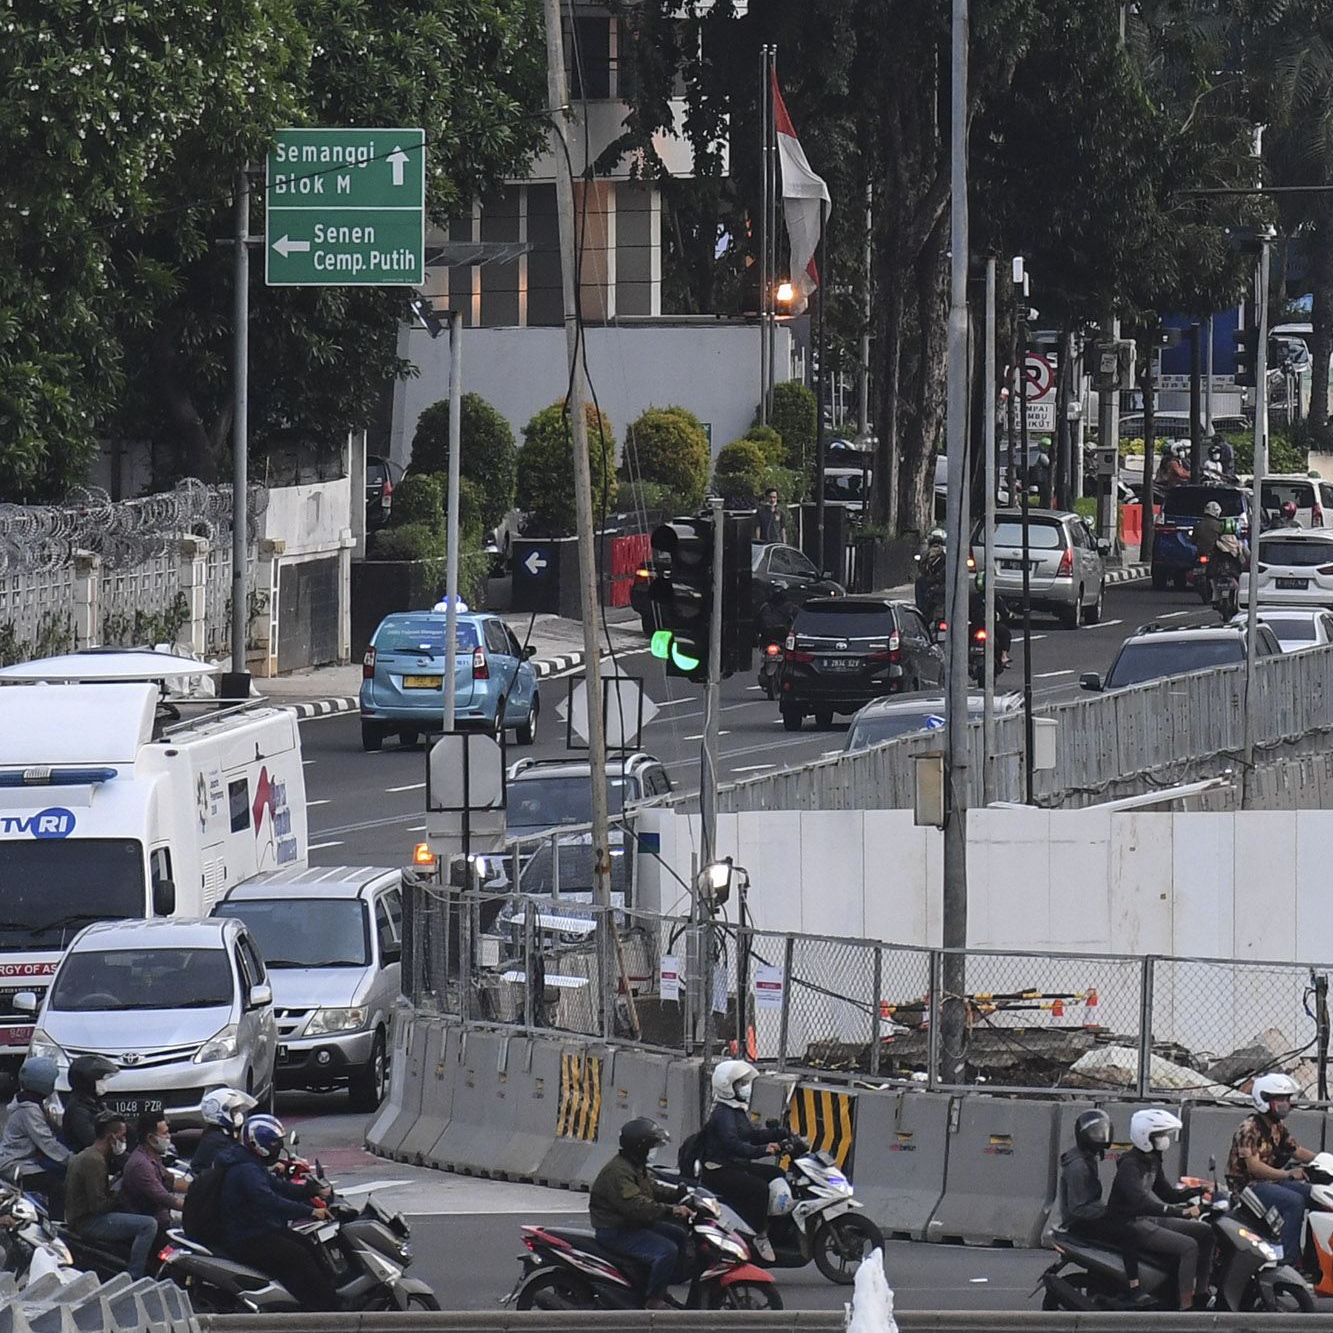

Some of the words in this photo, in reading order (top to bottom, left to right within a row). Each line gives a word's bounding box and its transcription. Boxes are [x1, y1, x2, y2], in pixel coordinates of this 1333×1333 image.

[275, 141, 375, 168] Semanggi
[275, 173, 324, 194] Blok
[337, 175, 351, 194] M
[314, 224, 375, 243] Senen
[1, 816, 69, 833] TVRI
[24, 965, 40, 974] OF
[115, 1101, 138, 1113] 1048
[144, 1100, 162, 1113] PZR
